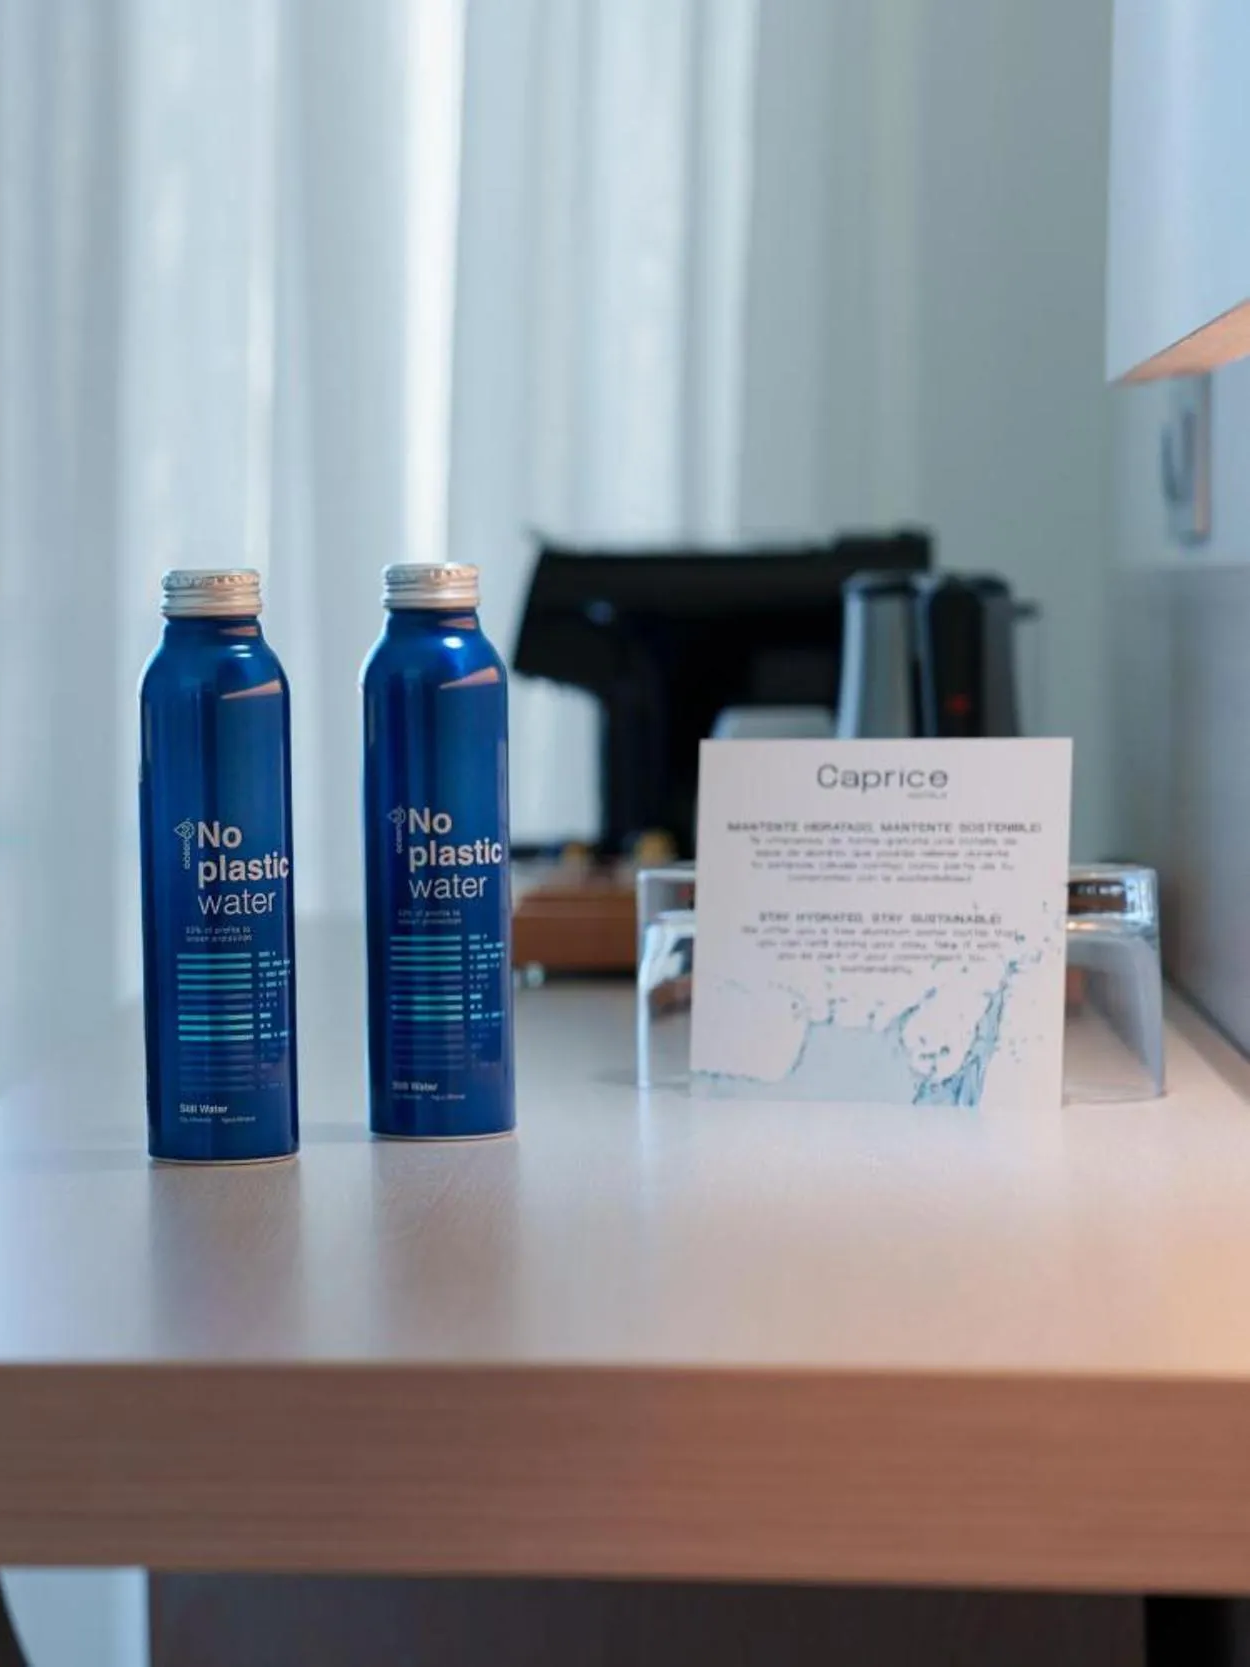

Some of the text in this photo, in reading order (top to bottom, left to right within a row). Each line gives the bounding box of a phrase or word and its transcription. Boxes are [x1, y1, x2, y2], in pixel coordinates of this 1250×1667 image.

[817, 764, 948, 792] Caprice
[408, 807, 452, 834] No
[197, 821, 242, 848] No
[409, 837, 502, 873] plastic
[198, 851, 289, 889] plastic
[408, 874, 487, 899] water
[197, 888, 276, 915] water
[179, 1103, 227, 1114] Still Water
